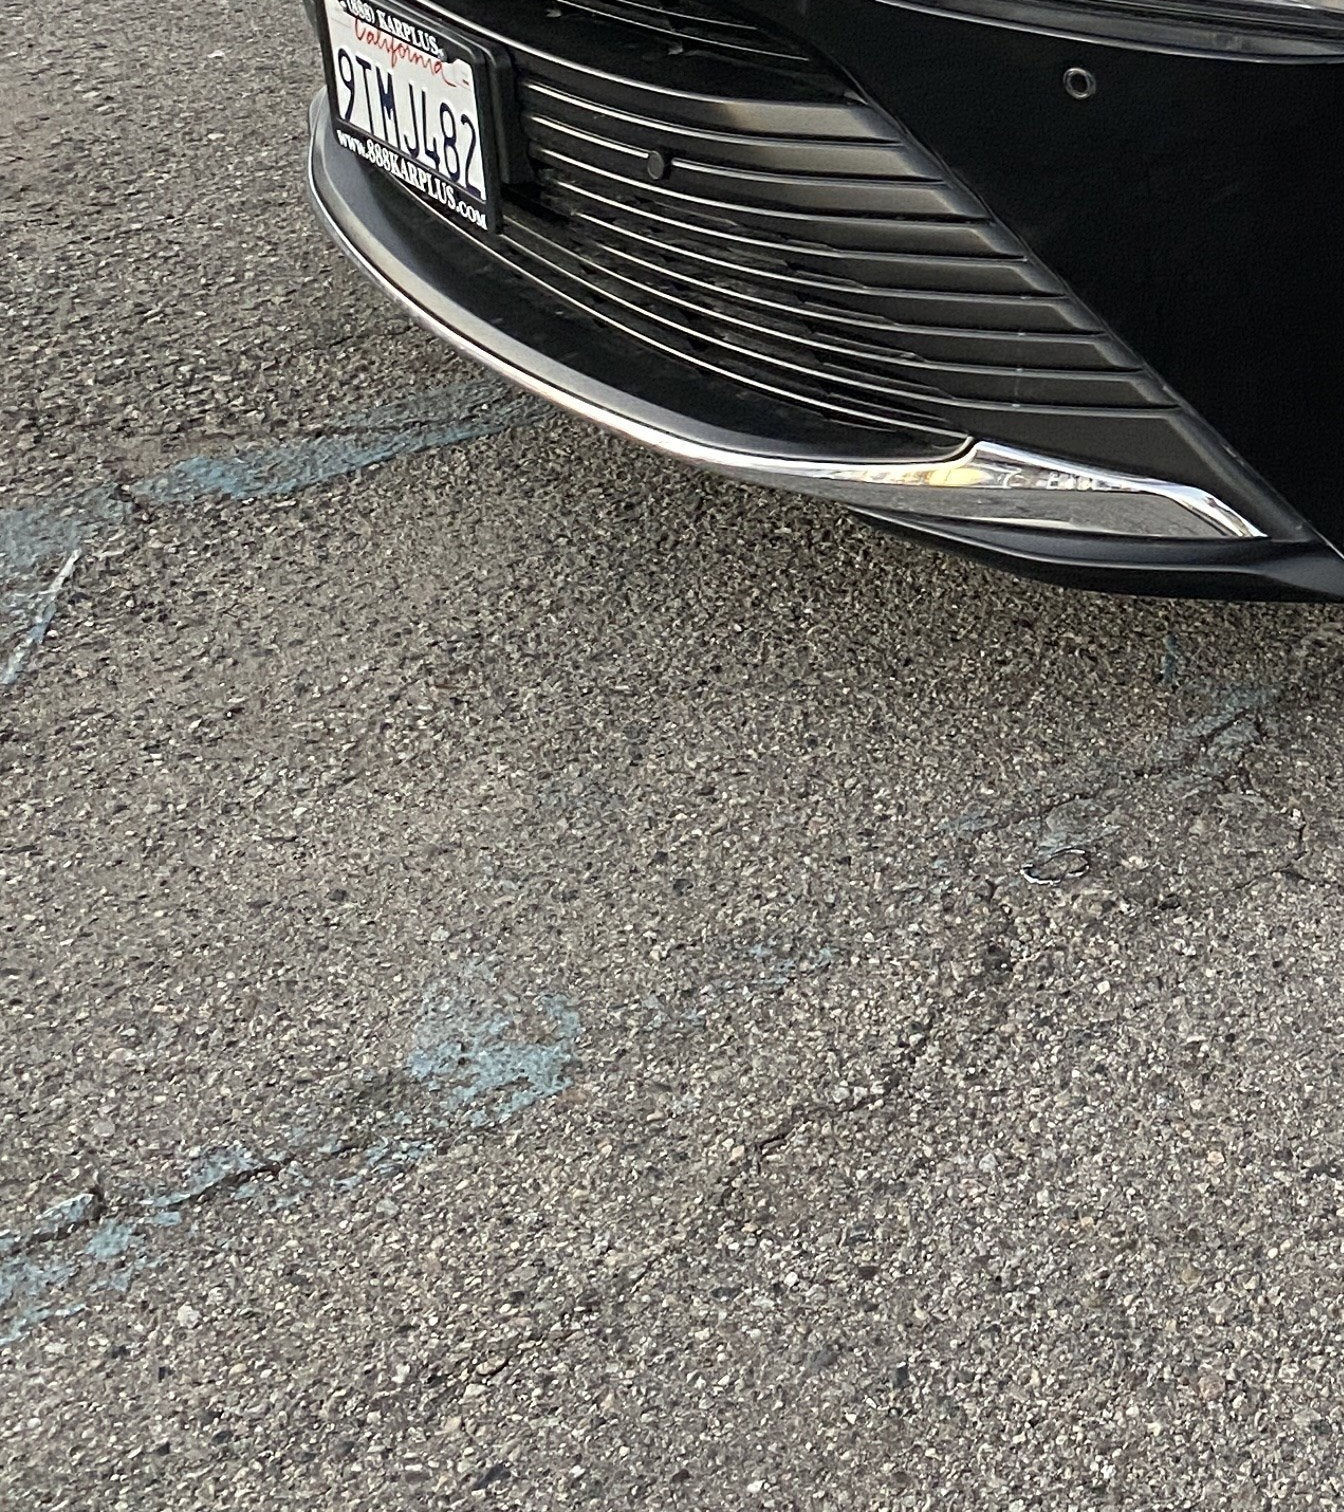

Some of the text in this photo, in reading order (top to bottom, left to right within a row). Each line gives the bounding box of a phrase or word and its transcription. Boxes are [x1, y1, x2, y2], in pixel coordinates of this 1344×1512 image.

[355, 18, 457, 87] California
[376, 9, 439, 54] KARPLUS
[338, 48, 485, 200] 9TMJ482
